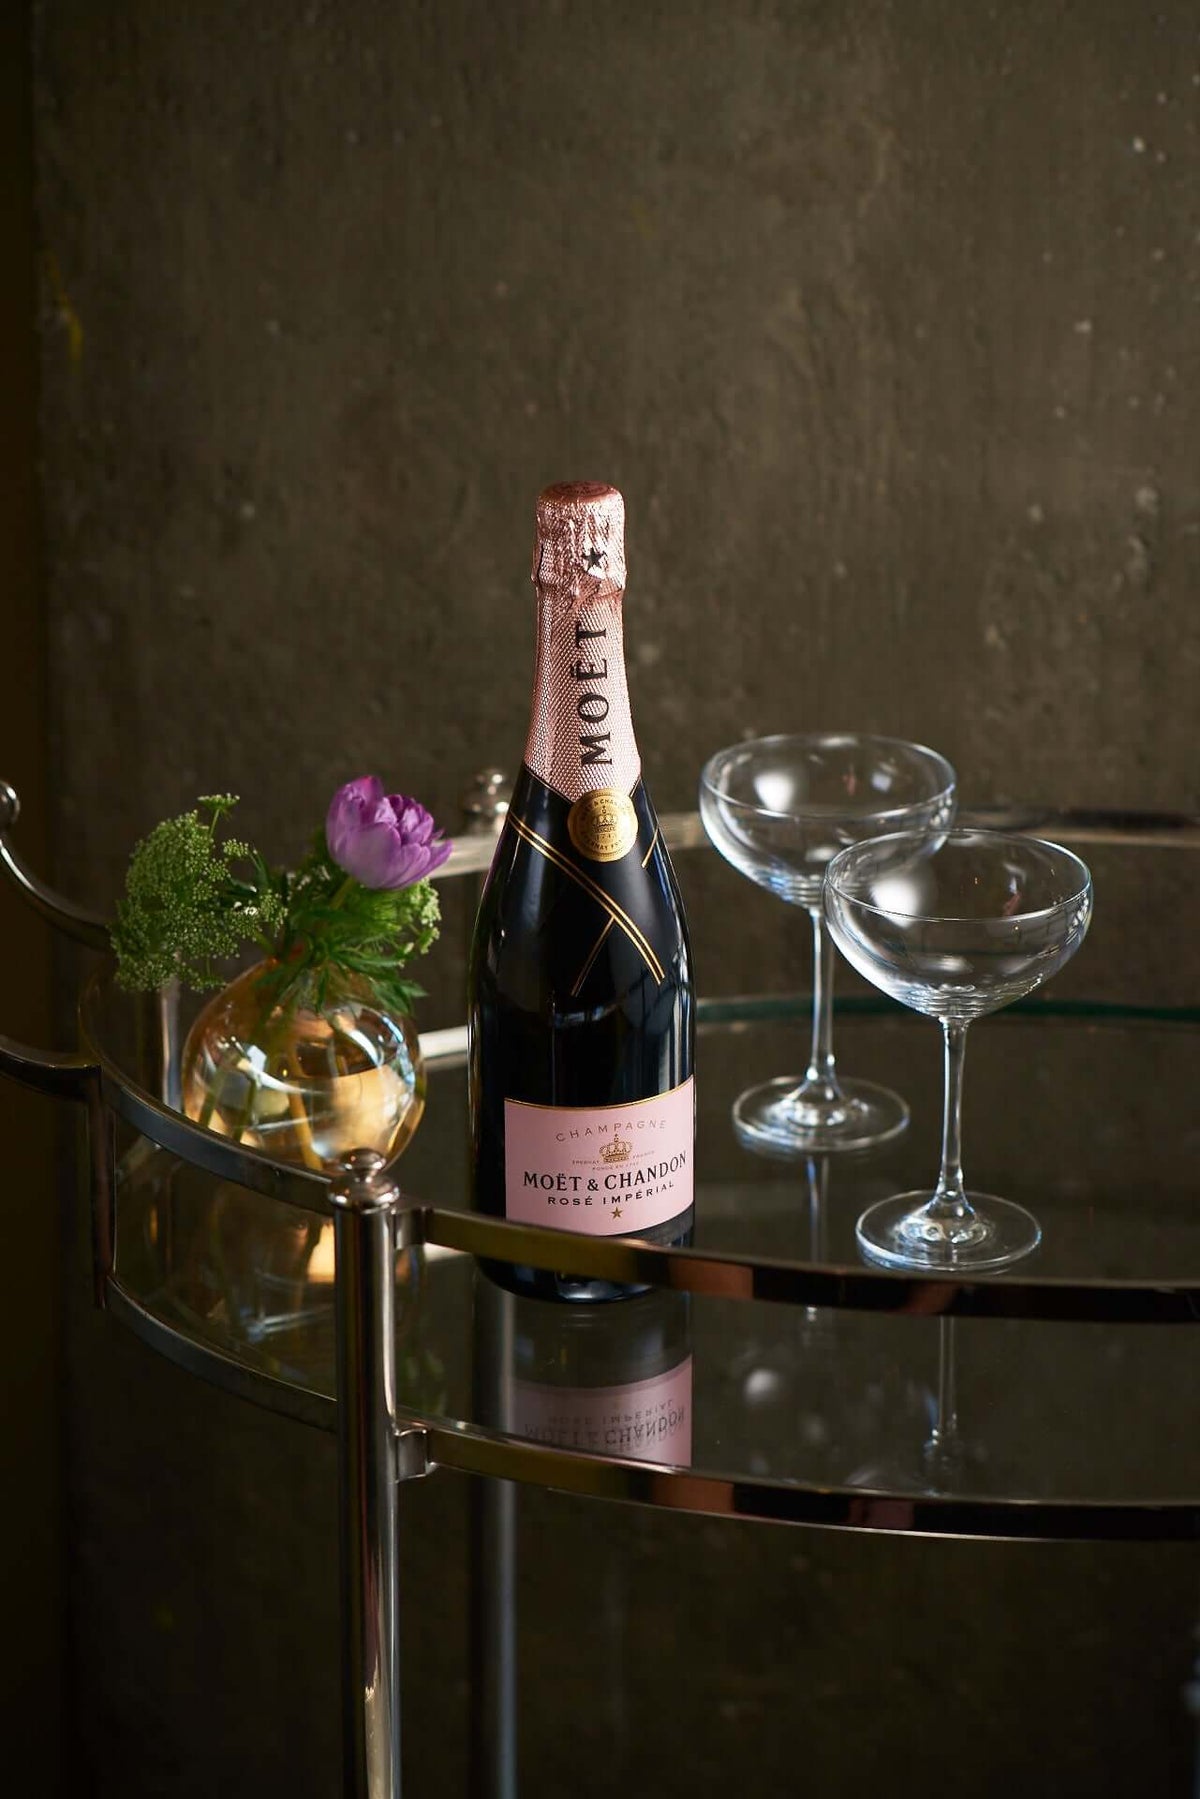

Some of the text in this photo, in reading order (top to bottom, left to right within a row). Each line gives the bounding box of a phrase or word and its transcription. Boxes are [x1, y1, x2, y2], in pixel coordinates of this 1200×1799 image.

[571, 620, 612, 765] MOËT
[556, 1119, 667, 1142] CHAMPAGNE
[523, 1171, 582, 1192] MOËT
[586, 1178, 599, 1192] &
[604, 1150, 687, 1190] CHANDON
[547, 1180, 674, 1206] ROSÉ IMPÉRIAL
